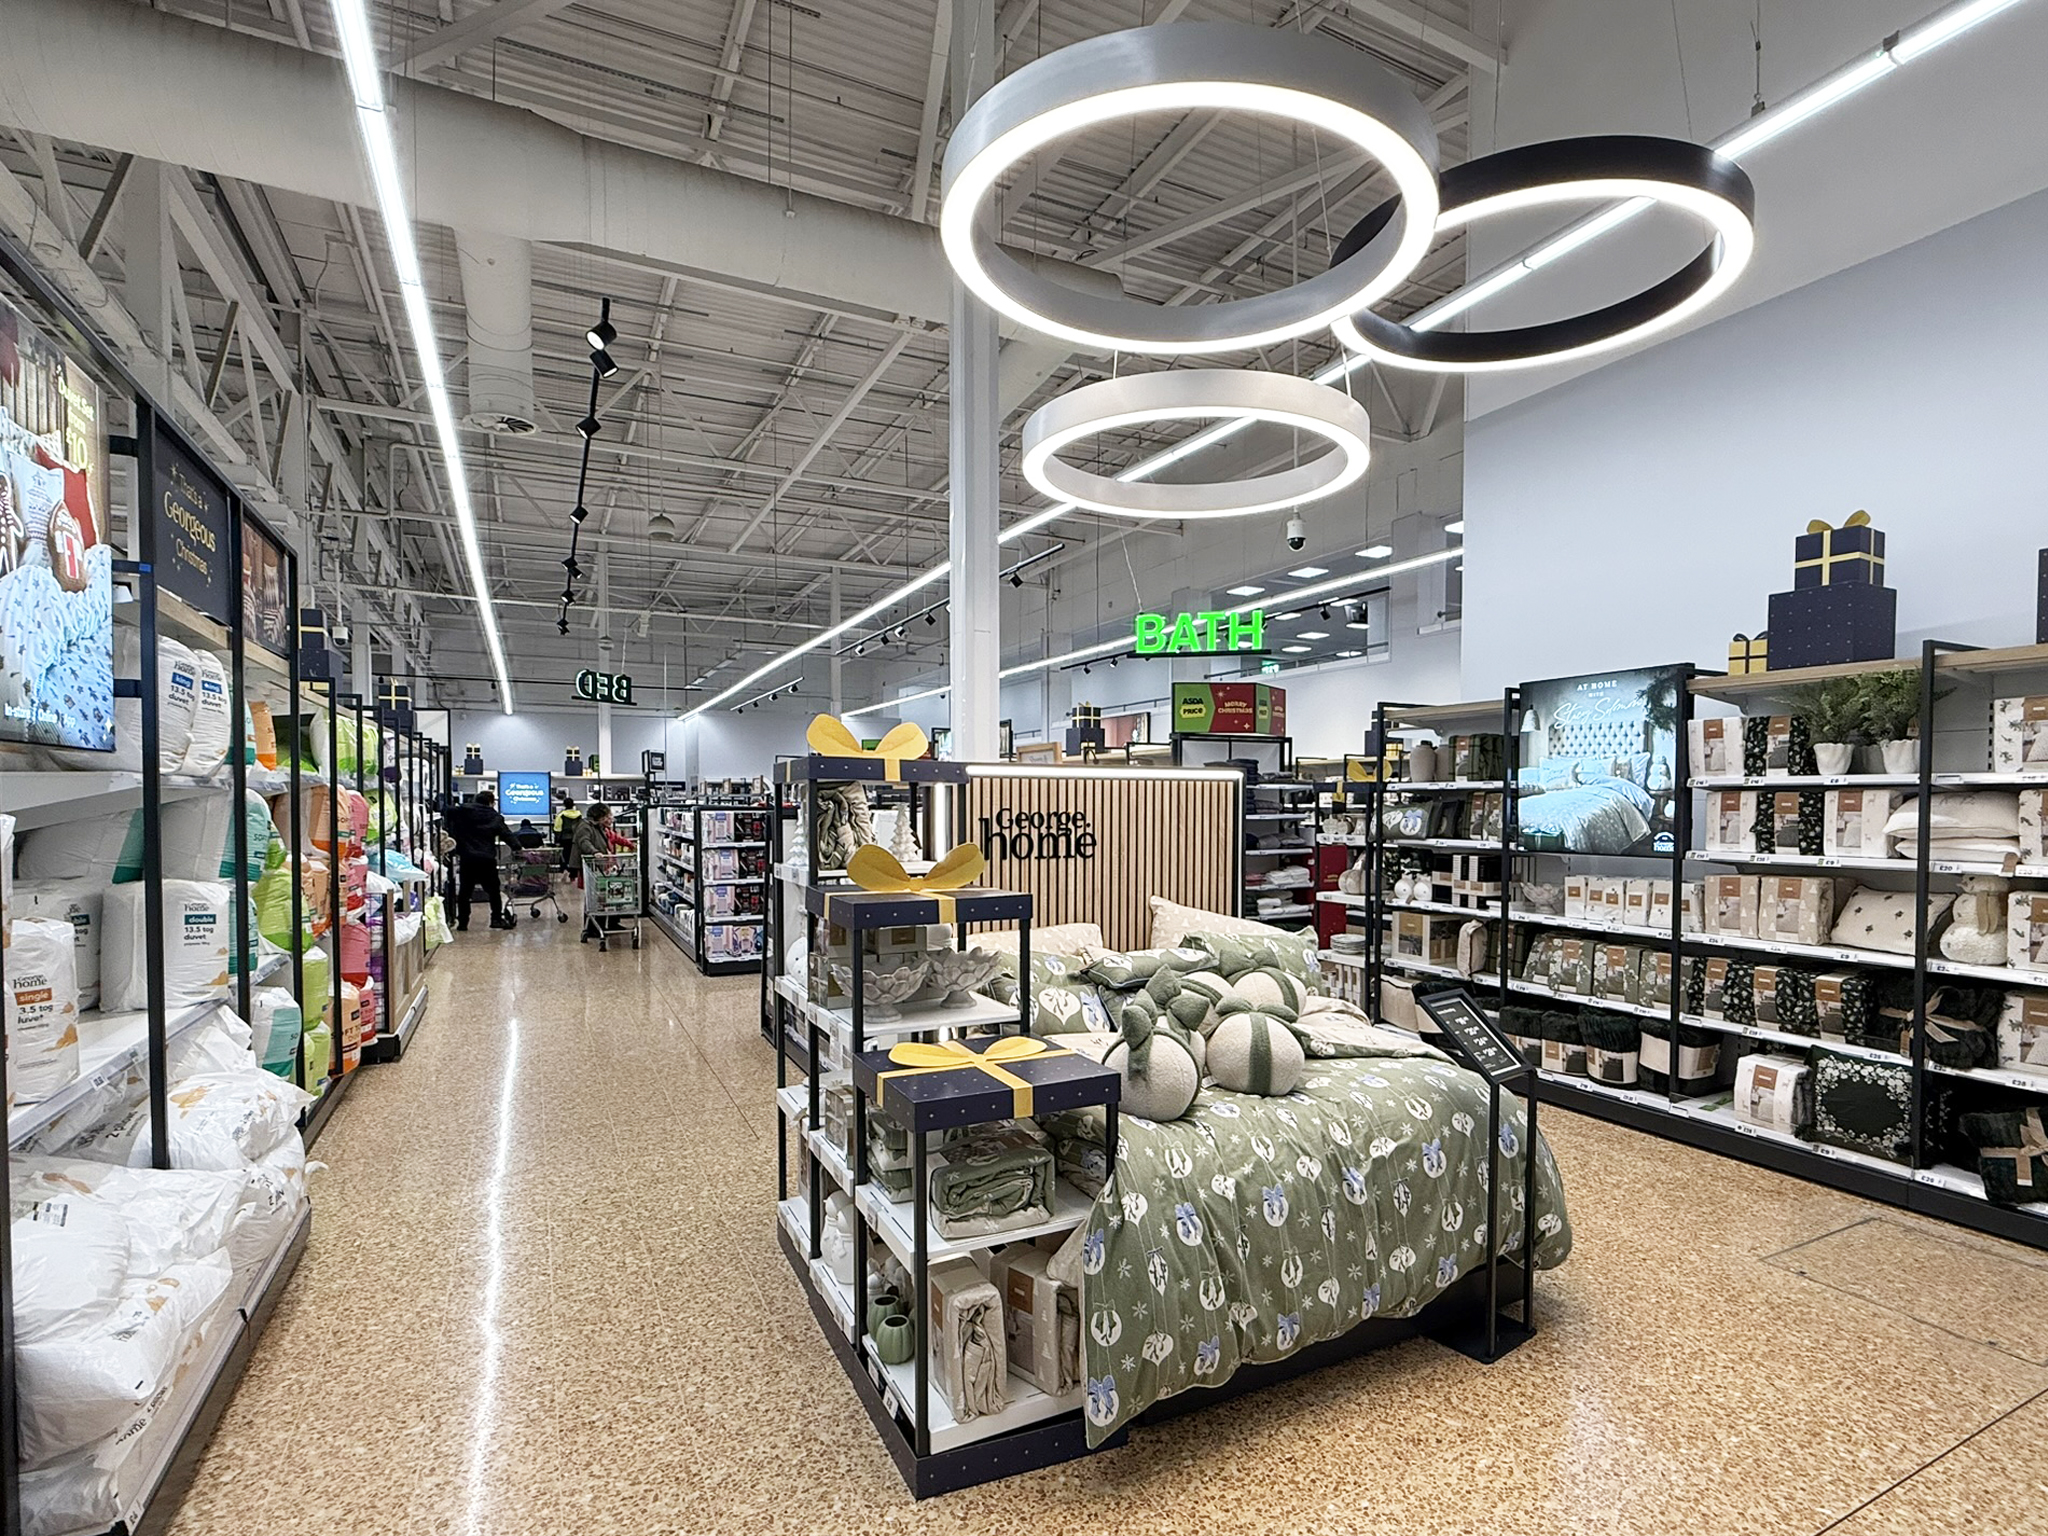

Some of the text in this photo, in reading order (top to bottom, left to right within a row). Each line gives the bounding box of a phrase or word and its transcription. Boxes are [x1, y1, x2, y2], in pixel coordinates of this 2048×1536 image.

[66, 427, 88, 470] £10
[176, 538, 208, 575] Christmas
[1135, 610, 1264, 654] BATH
[176, 674, 191, 687] king
[1591, 680, 1618, 689] HOME
[170, 685, 186, 696] 13.5
[202, 692, 216, 700] 13.5
[168, 692, 190, 706] duvet
[202, 699, 222, 708] duvet
[1224, 700, 1248, 708] MERRY
[38, 708, 58, 724] Online
[978, 818, 1097, 860] home
[13, 978, 48, 989] home
[20, 992, 48, 1002] single
[39, 1004, 53, 1013] tog
